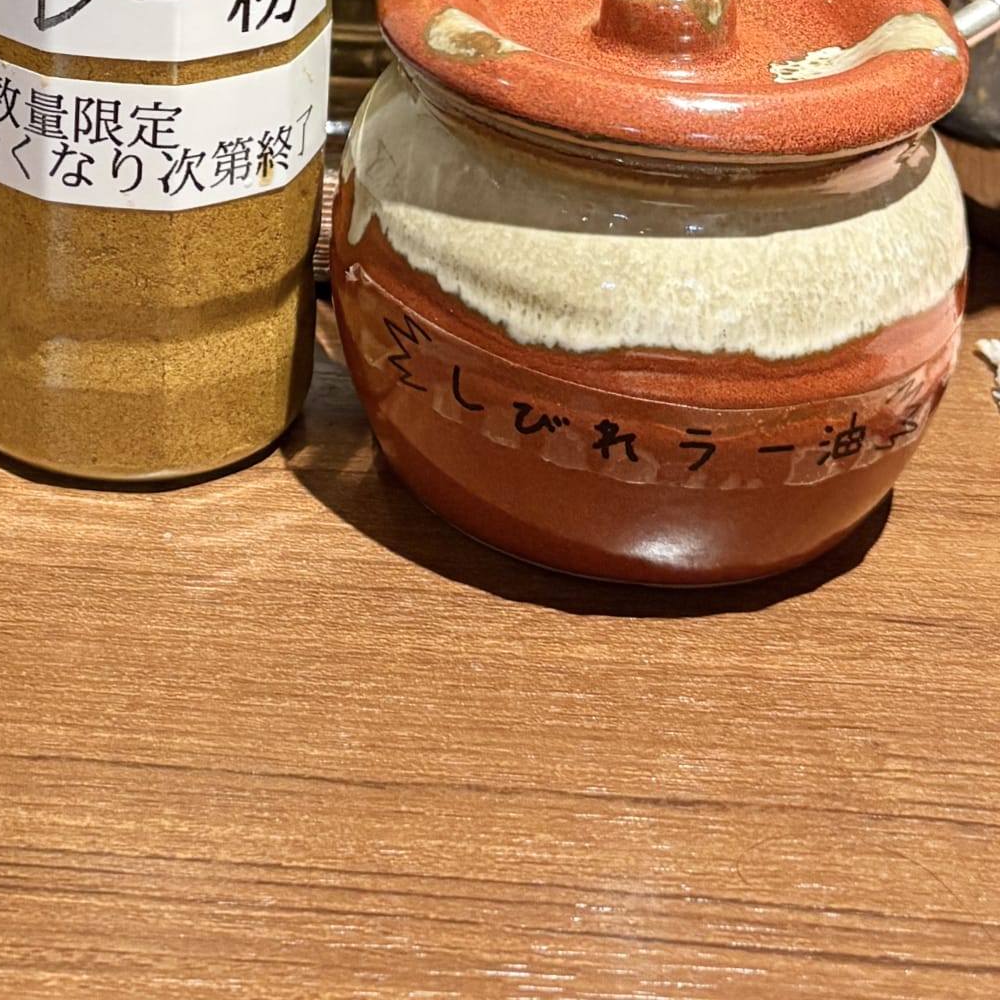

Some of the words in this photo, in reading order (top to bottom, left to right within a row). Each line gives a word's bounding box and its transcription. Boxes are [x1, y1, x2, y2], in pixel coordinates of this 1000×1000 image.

[452, 364, 868, 472] しびれラー油
